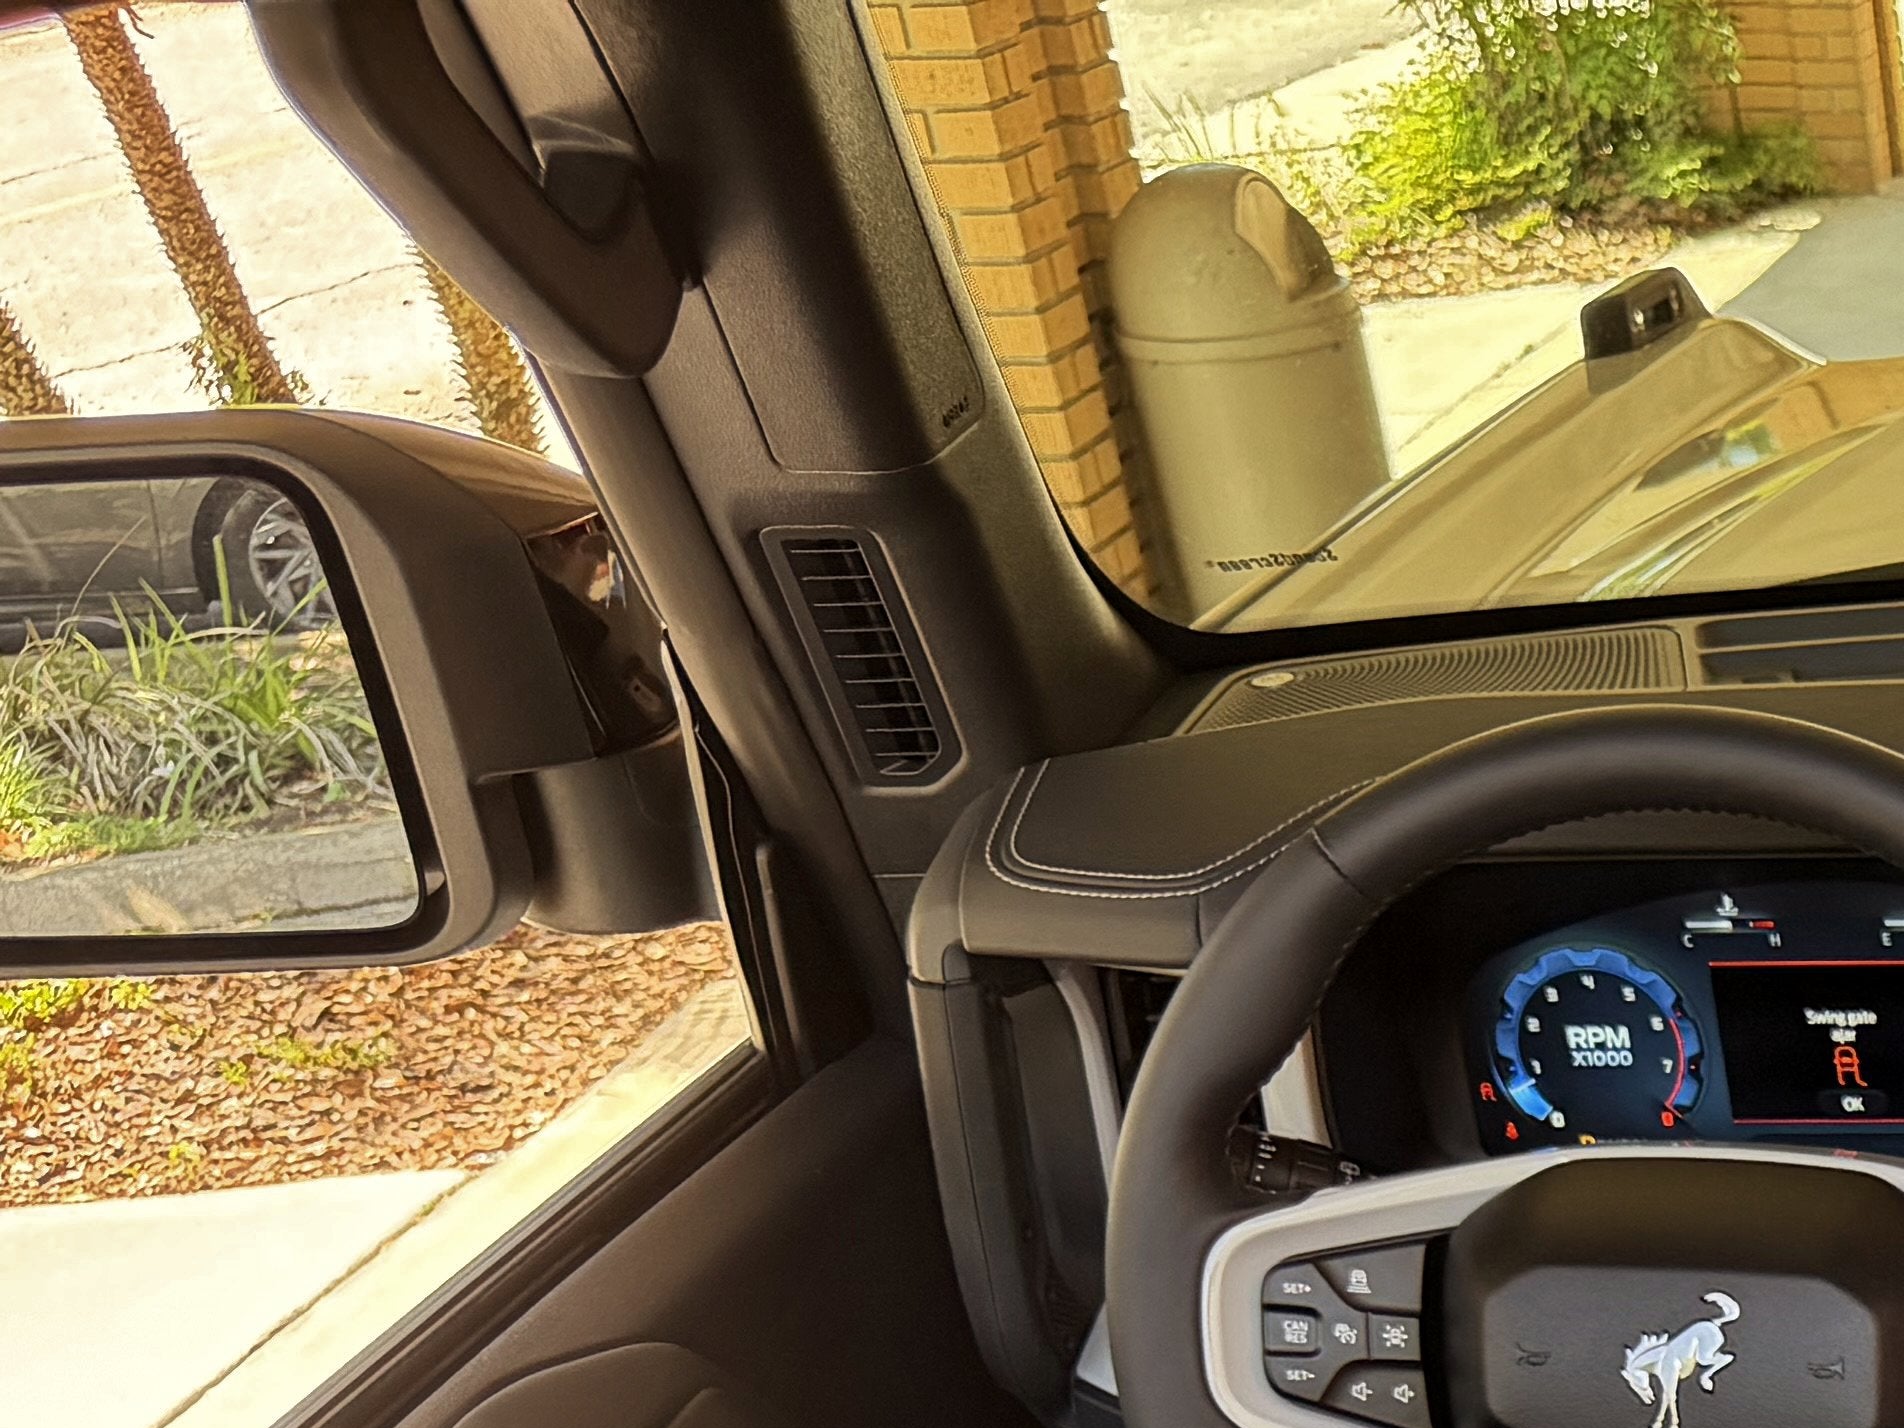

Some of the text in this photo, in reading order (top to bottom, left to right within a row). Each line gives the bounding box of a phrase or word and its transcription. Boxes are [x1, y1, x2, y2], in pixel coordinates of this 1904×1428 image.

[1682, 934, 1693, 948] C
[1768, 933, 1782, 947] H
[1881, 933, 1893, 947] E
[1580, 974, 1595, 990] 4
[1544, 986, 1559, 1003] 3
[1621, 985, 1636, 1002] 5
[1526, 1016, 1541, 1033] 2
[1564, 1026, 1631, 1049] RPM
[1572, 1050, 1633, 1067] X1000
[1662, 1058, 1673, 1074] 7
[1531, 1059, 1542, 1075] 1
[1283, 1320, 1309, 1331] CAN
